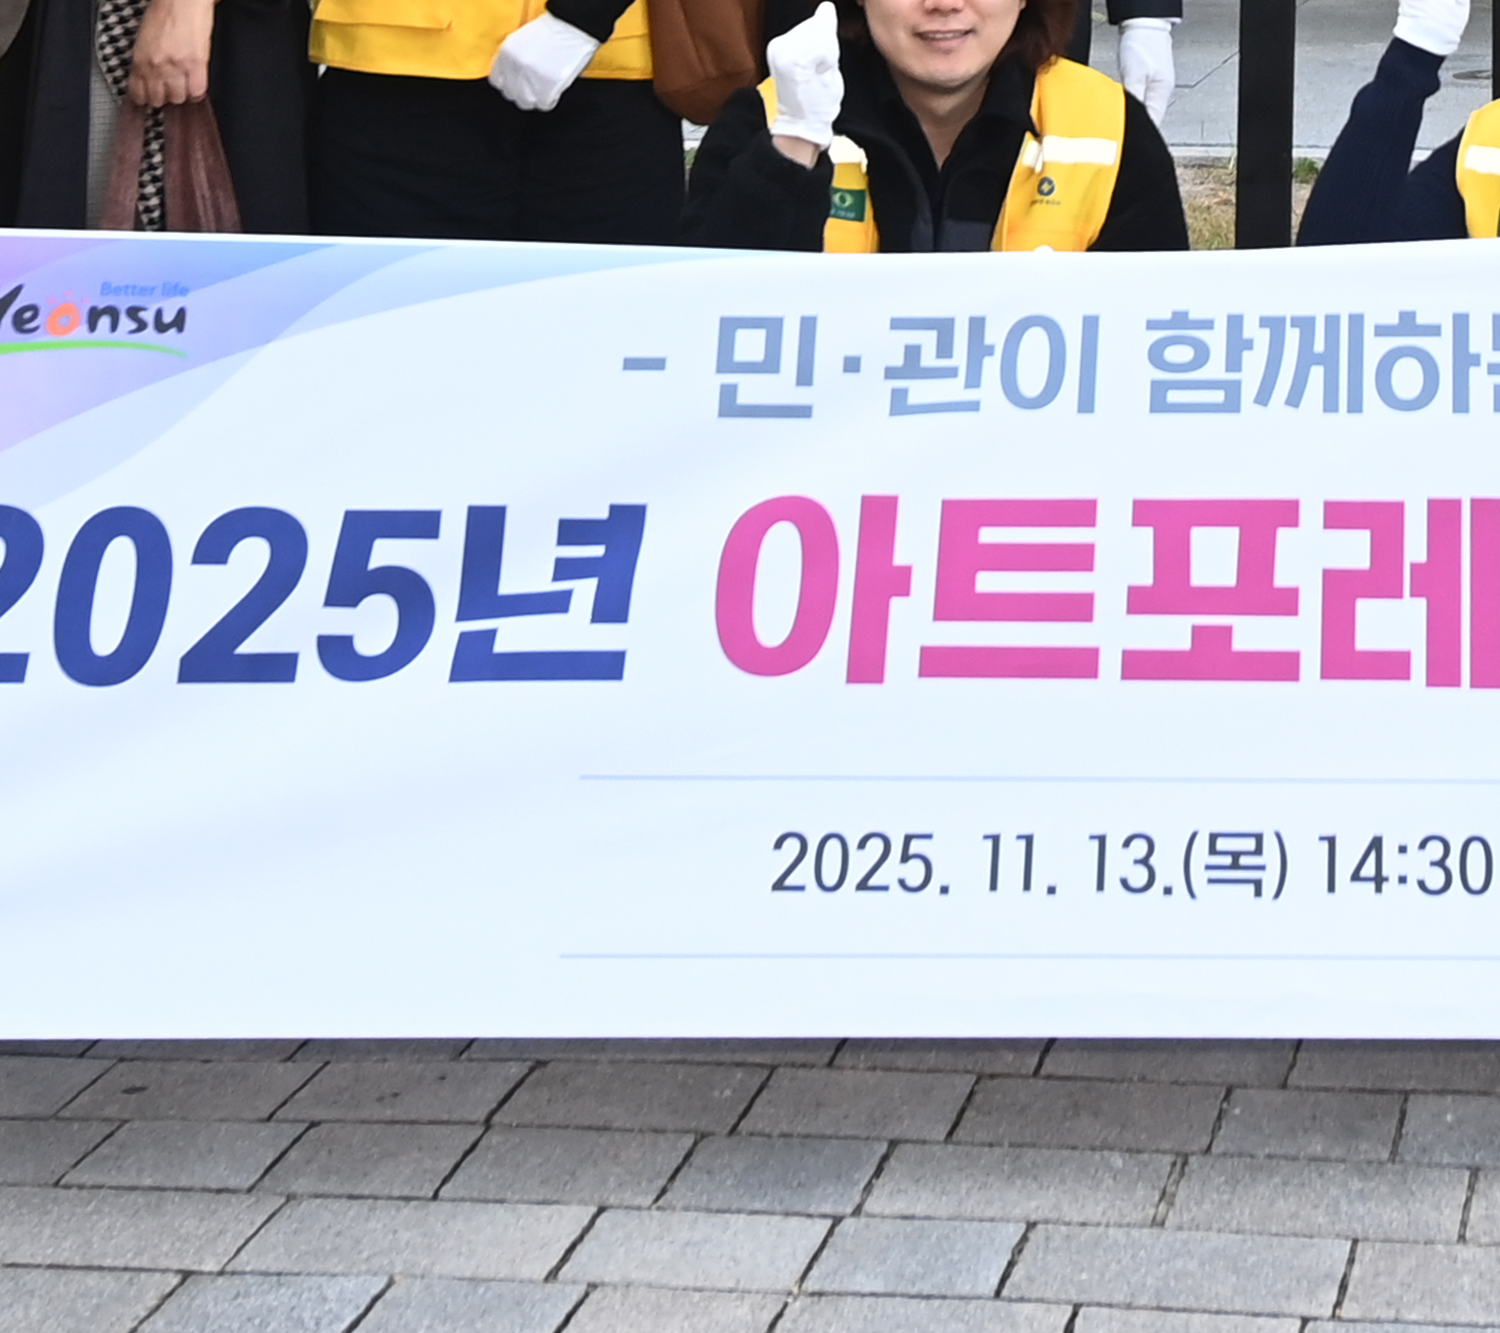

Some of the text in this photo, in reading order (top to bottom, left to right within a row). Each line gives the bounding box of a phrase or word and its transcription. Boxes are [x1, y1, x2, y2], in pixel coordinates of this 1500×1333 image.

[100, 281, 190, 298] Better life
[715, 314, 1100, 420] 민·관이
[770, 829, 1494, 901] 2025. 11. 13.(목) 14:30
